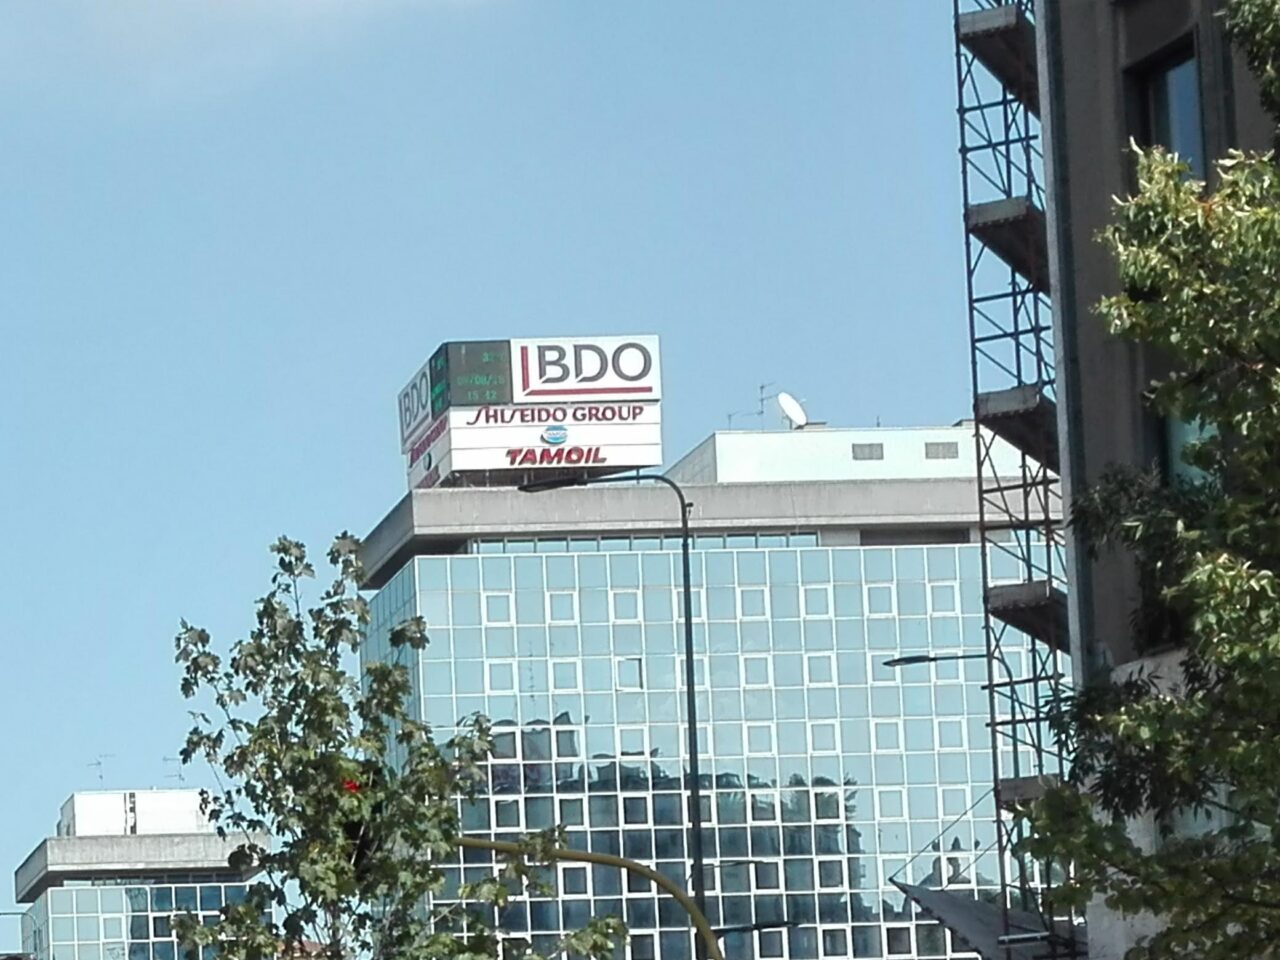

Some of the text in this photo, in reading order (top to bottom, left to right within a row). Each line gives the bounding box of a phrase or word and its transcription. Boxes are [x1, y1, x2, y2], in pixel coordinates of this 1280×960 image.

[536, 342, 653, 384] BDO
[466, 405, 644, 425] SHISEIDO GROUP
[506, 446, 607, 466] TAMOIL
